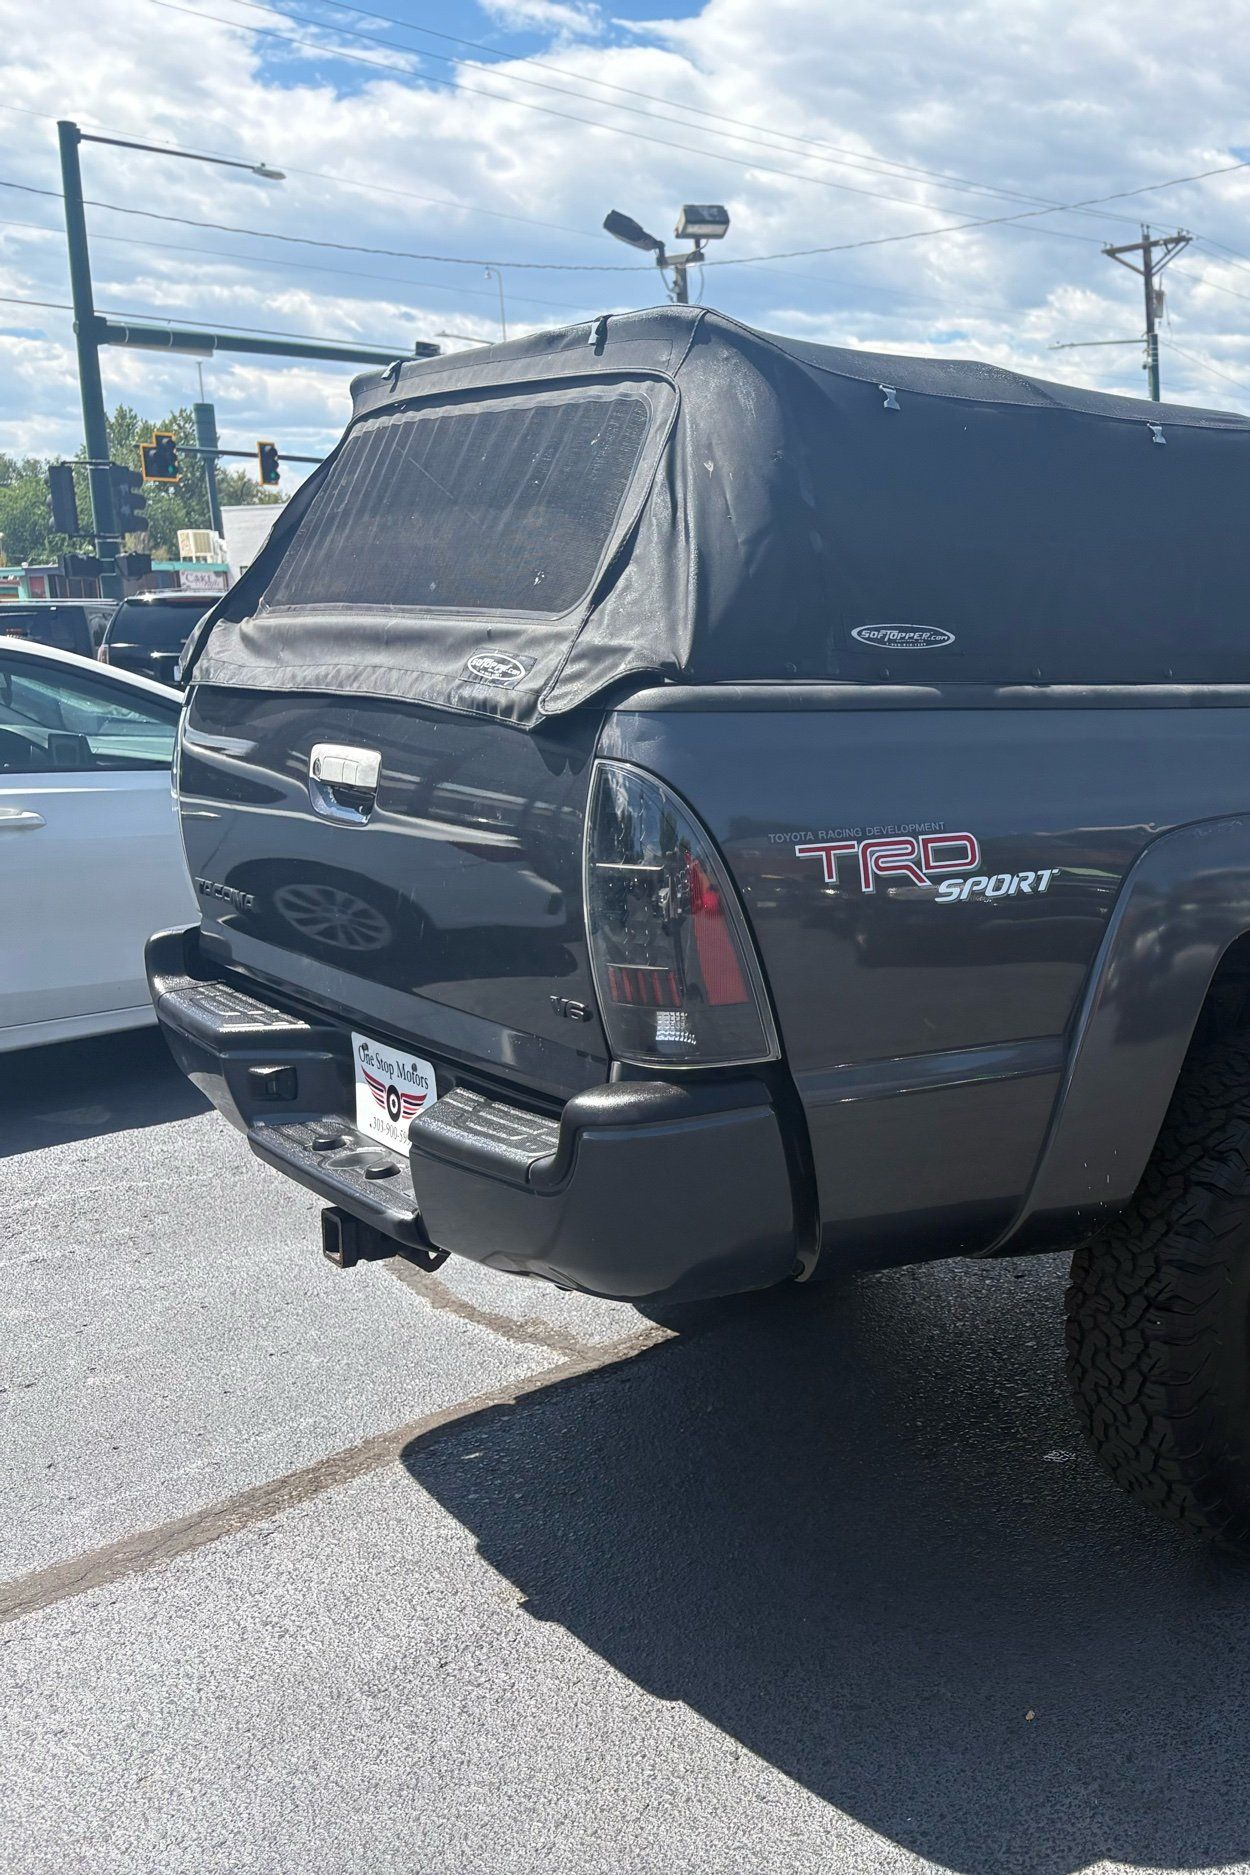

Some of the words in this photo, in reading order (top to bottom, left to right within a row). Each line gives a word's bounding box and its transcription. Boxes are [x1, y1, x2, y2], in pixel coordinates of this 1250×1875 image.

[768, 831, 814, 843] TOYOTA
[818, 827, 862, 840] RACING
[866, 821, 945, 836] DEVELOPMENT
[795, 832, 981, 894] TRD
[935, 868, 1060, 903] SPORT
[358, 1044, 375, 1066] One
[375, 1053, 395, 1080] Stop
[396, 1061, 429, 1090] Motors
